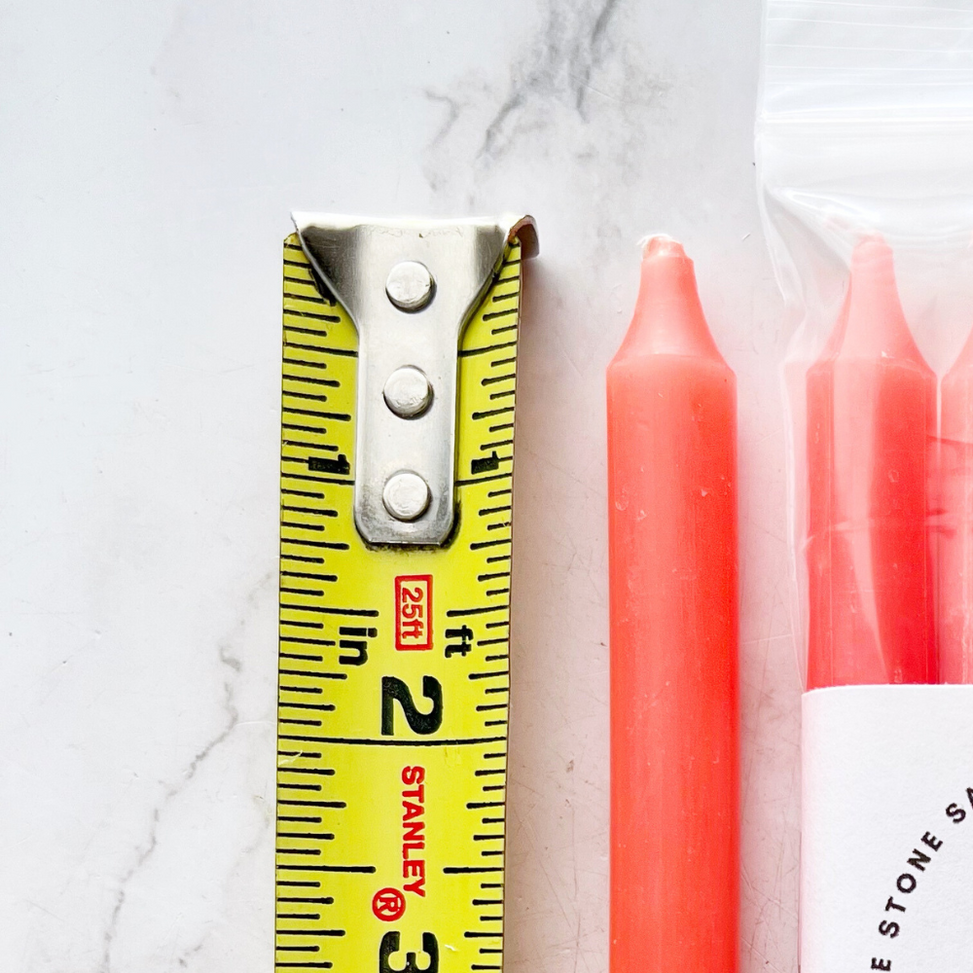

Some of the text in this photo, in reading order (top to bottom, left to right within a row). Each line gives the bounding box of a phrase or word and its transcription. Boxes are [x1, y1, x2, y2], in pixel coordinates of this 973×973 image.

[402, 586, 425, 642] 25ft
[445, 624, 474, 658] ft
[339, 626, 378, 666] in
[381, 675, 443, 737] 2
[401, 765, 427, 898] STANLEY
[878, 829, 944, 939] STONE
